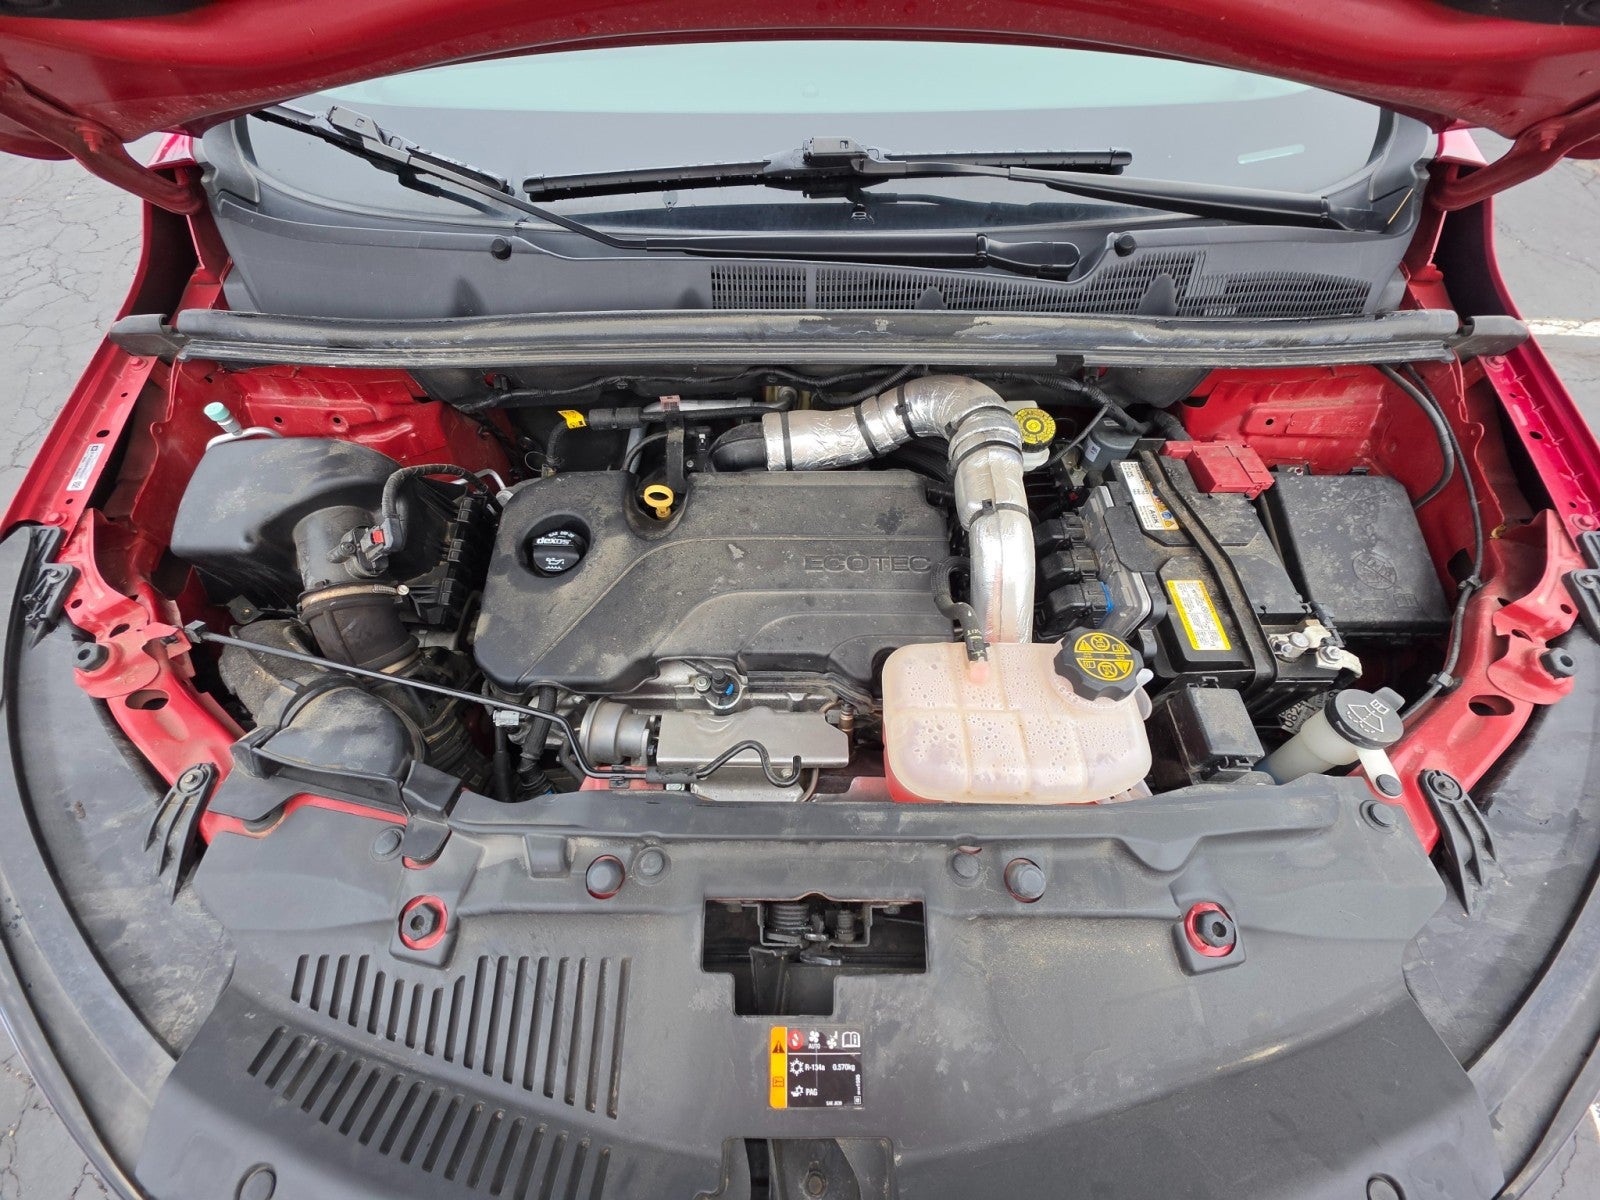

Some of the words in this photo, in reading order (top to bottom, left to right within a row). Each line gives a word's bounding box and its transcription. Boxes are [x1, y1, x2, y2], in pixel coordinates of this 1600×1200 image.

[803, 554, 932, 574] ECOTEC
[804, 1063, 826, 1071] R-134a
[832, 1063, 856, 1072] 0.570kg
[805, 1087, 818, 1096] PAG
